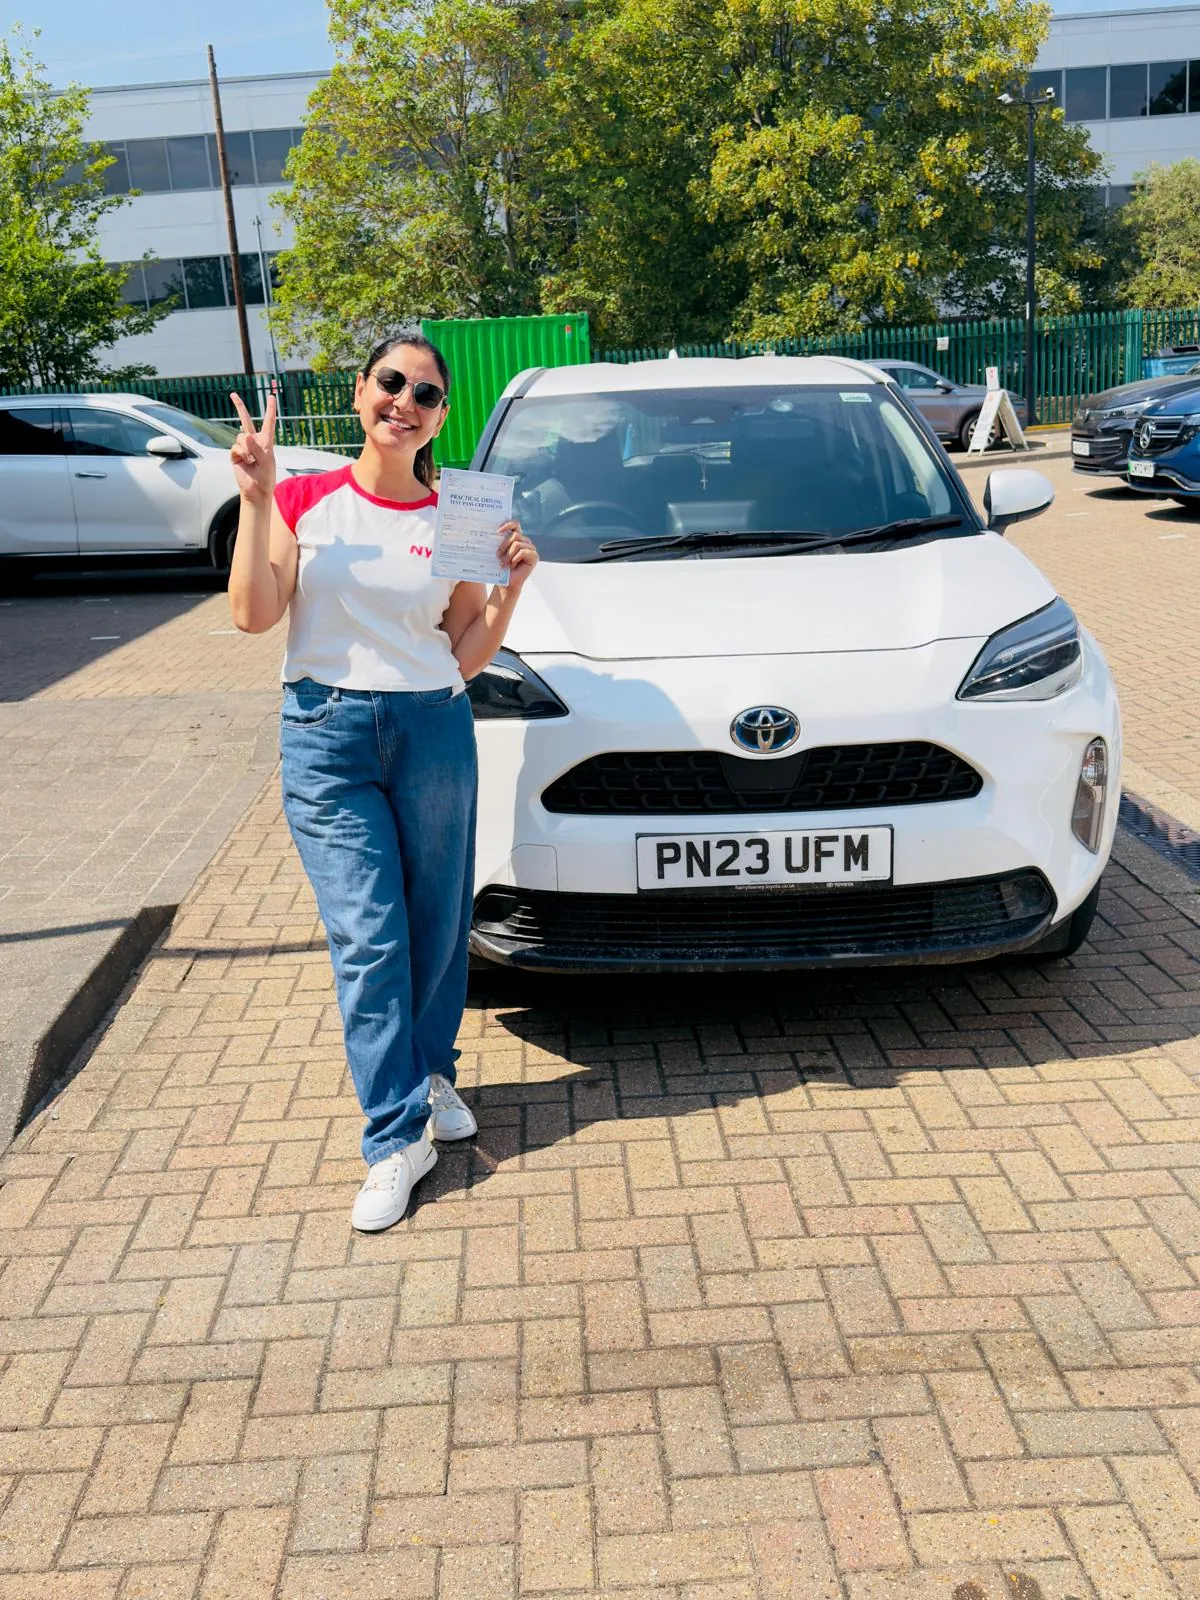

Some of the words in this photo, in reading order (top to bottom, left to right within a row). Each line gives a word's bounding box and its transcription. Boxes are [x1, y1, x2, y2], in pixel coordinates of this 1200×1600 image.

[450, 494, 480, 502] PRACTICAL
[480, 497, 504, 505] DRIVING
[656, 838, 770, 879] PN23
[785, 834, 869, 873] UFM
